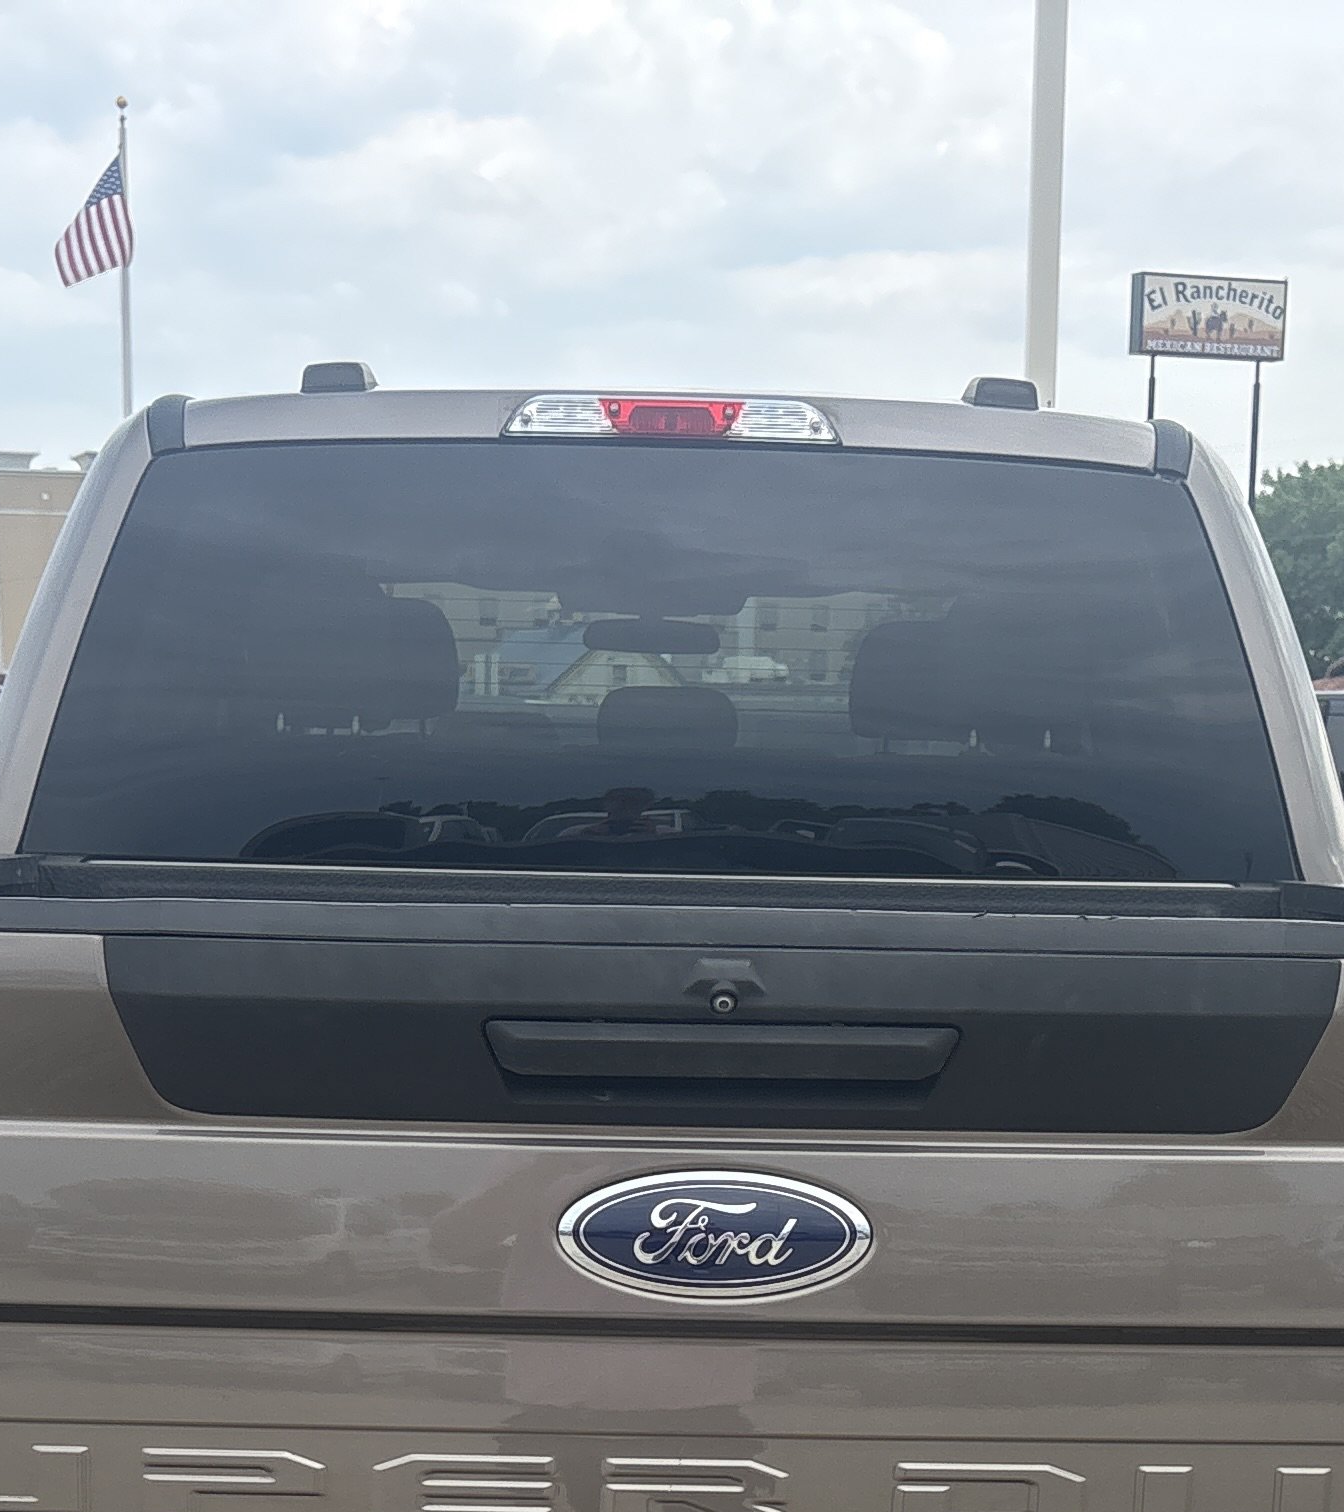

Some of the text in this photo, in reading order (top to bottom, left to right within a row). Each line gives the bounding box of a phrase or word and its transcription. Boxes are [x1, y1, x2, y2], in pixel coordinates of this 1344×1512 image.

[1144, 281, 1285, 320] El Rancherito
[1146, 339, 1281, 357] MEXICAN RESTAURANT
[632, 1198, 798, 1266] Ford
